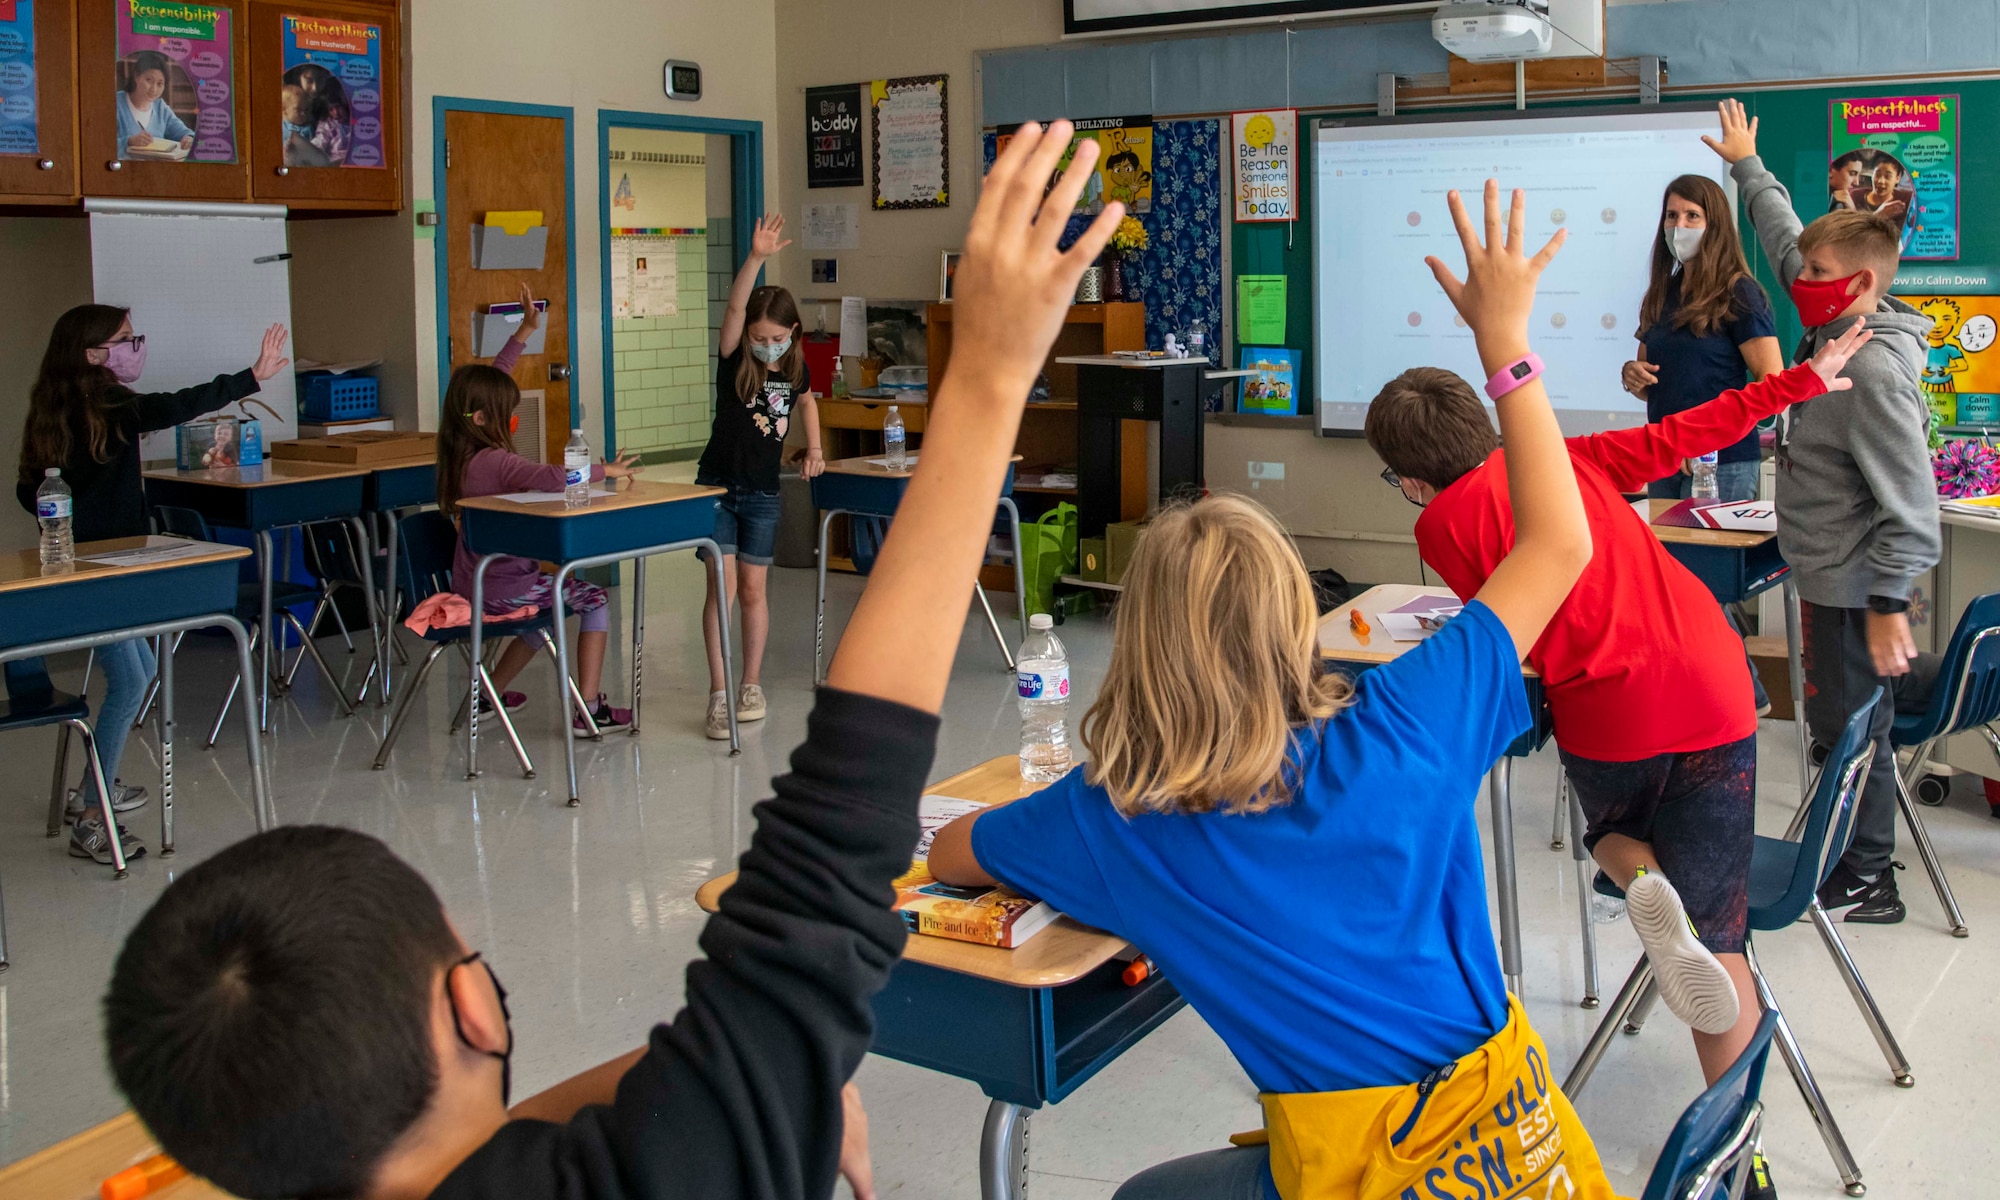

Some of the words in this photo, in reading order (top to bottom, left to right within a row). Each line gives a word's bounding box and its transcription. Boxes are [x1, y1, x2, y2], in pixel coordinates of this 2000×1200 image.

[128, 0, 221, 27] Responsibility
[287, 16, 377, 40] Trustworthiness
[820, 100, 836, 116] Be
[838, 101, 847, 113] a
[1841, 99, 1948, 120] Respectfulness
[812, 114, 858, 134] buddy
[1076, 118, 1124, 130] BULLYING
[814, 135, 841, 152] NOT
[1106, 127, 1145, 154] Refuse
[1240, 144, 1256, 158] Be
[1262, 142, 1288, 156] The
[814, 150, 856, 168] BULLY!
[1240, 158, 1288, 171] Reason
[1241, 172, 1288, 183] Someone
[1242, 184, 1288, 199] Smiles
[1892, 277, 1912, 285] ow
[1913, 276, 1924, 285] to
[1926, 276, 1951, 285] Calm
[1954, 276, 1987, 285] Down
[1968, 395, 1990, 404] Calm
[1028, 680, 1042, 691] Life
[924, 916, 942, 929] Fire
[944, 922, 962, 934] and
[965, 923, 979, 936] Ice
[1470, 1045, 1546, 1142] OLO
[1525, 1126, 1562, 1173] SINCE
[1400, 1137, 1522, 1200] SSN.
